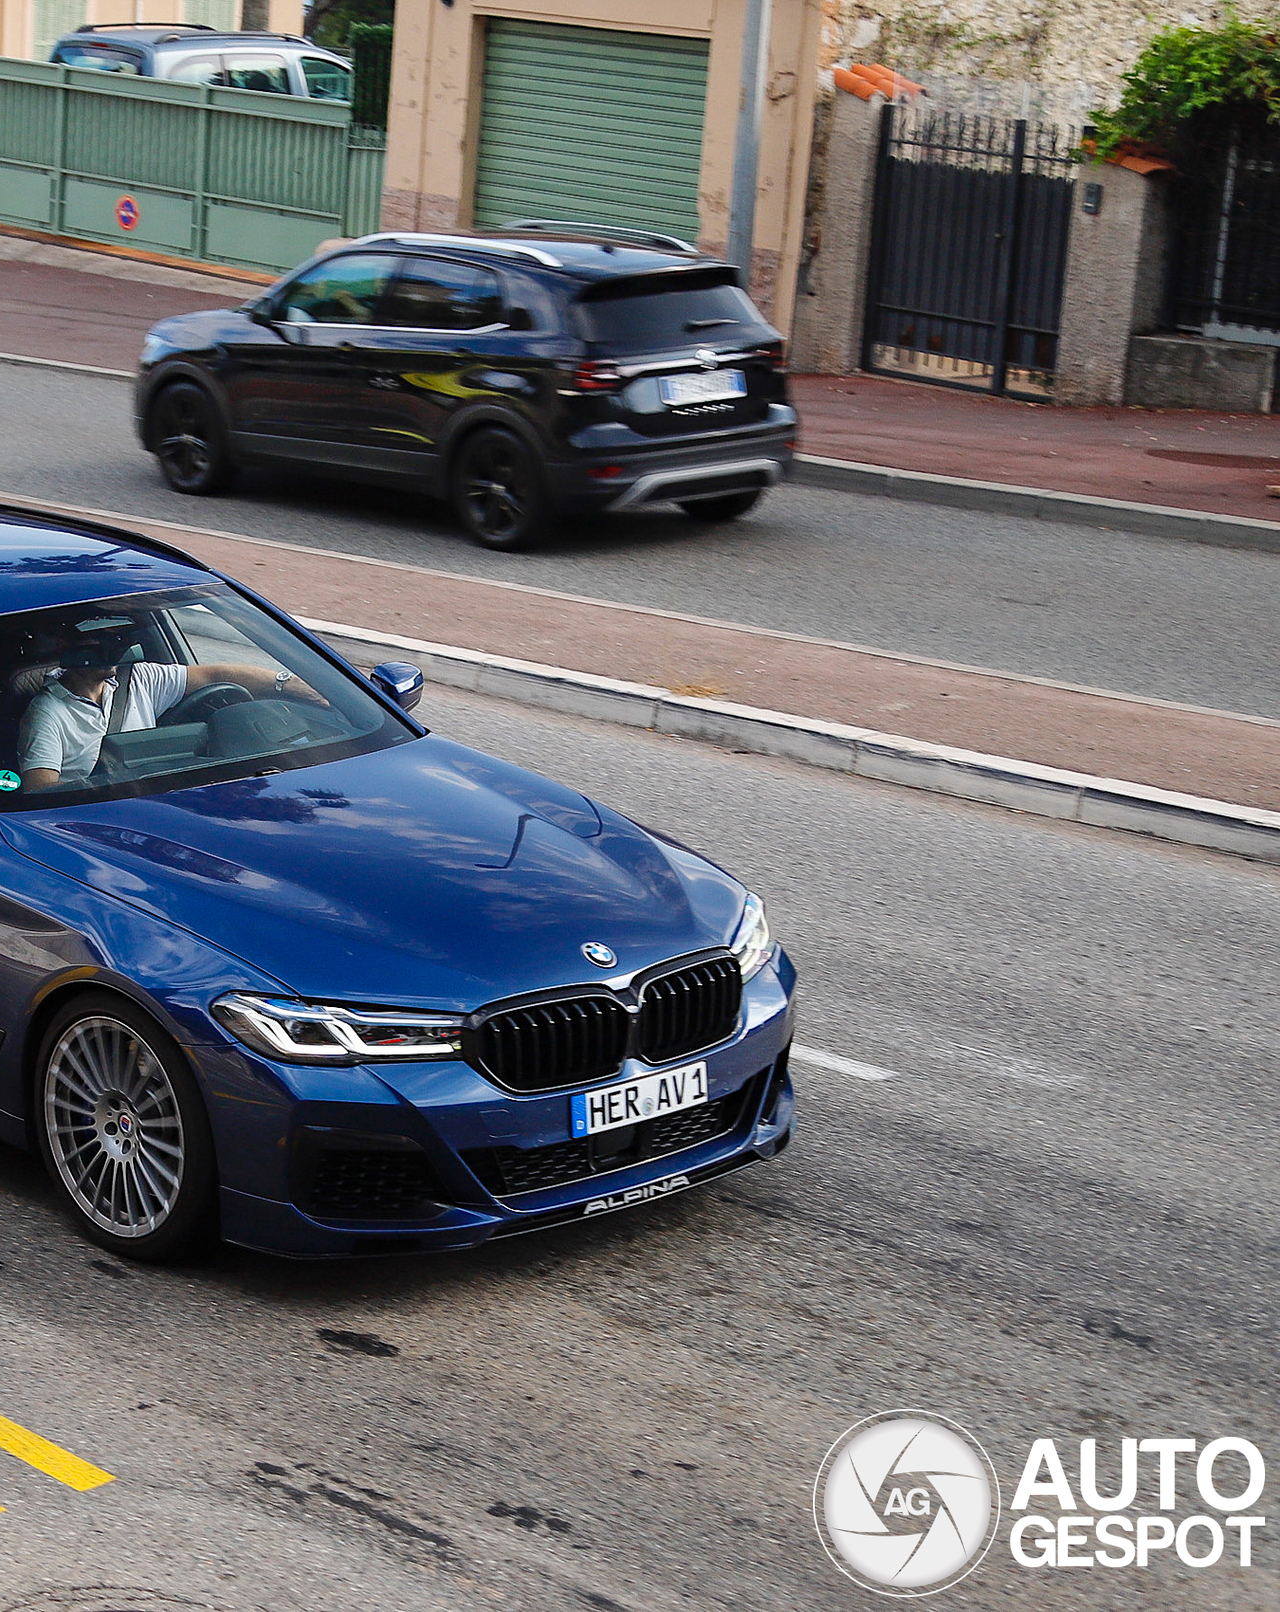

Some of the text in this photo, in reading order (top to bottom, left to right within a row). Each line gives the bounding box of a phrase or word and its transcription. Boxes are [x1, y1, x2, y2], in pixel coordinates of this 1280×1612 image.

[2, 771, 11, 781] 4
[590, 1085, 641, 1128] HER
[583, 1175, 691, 1215] ALPINA
